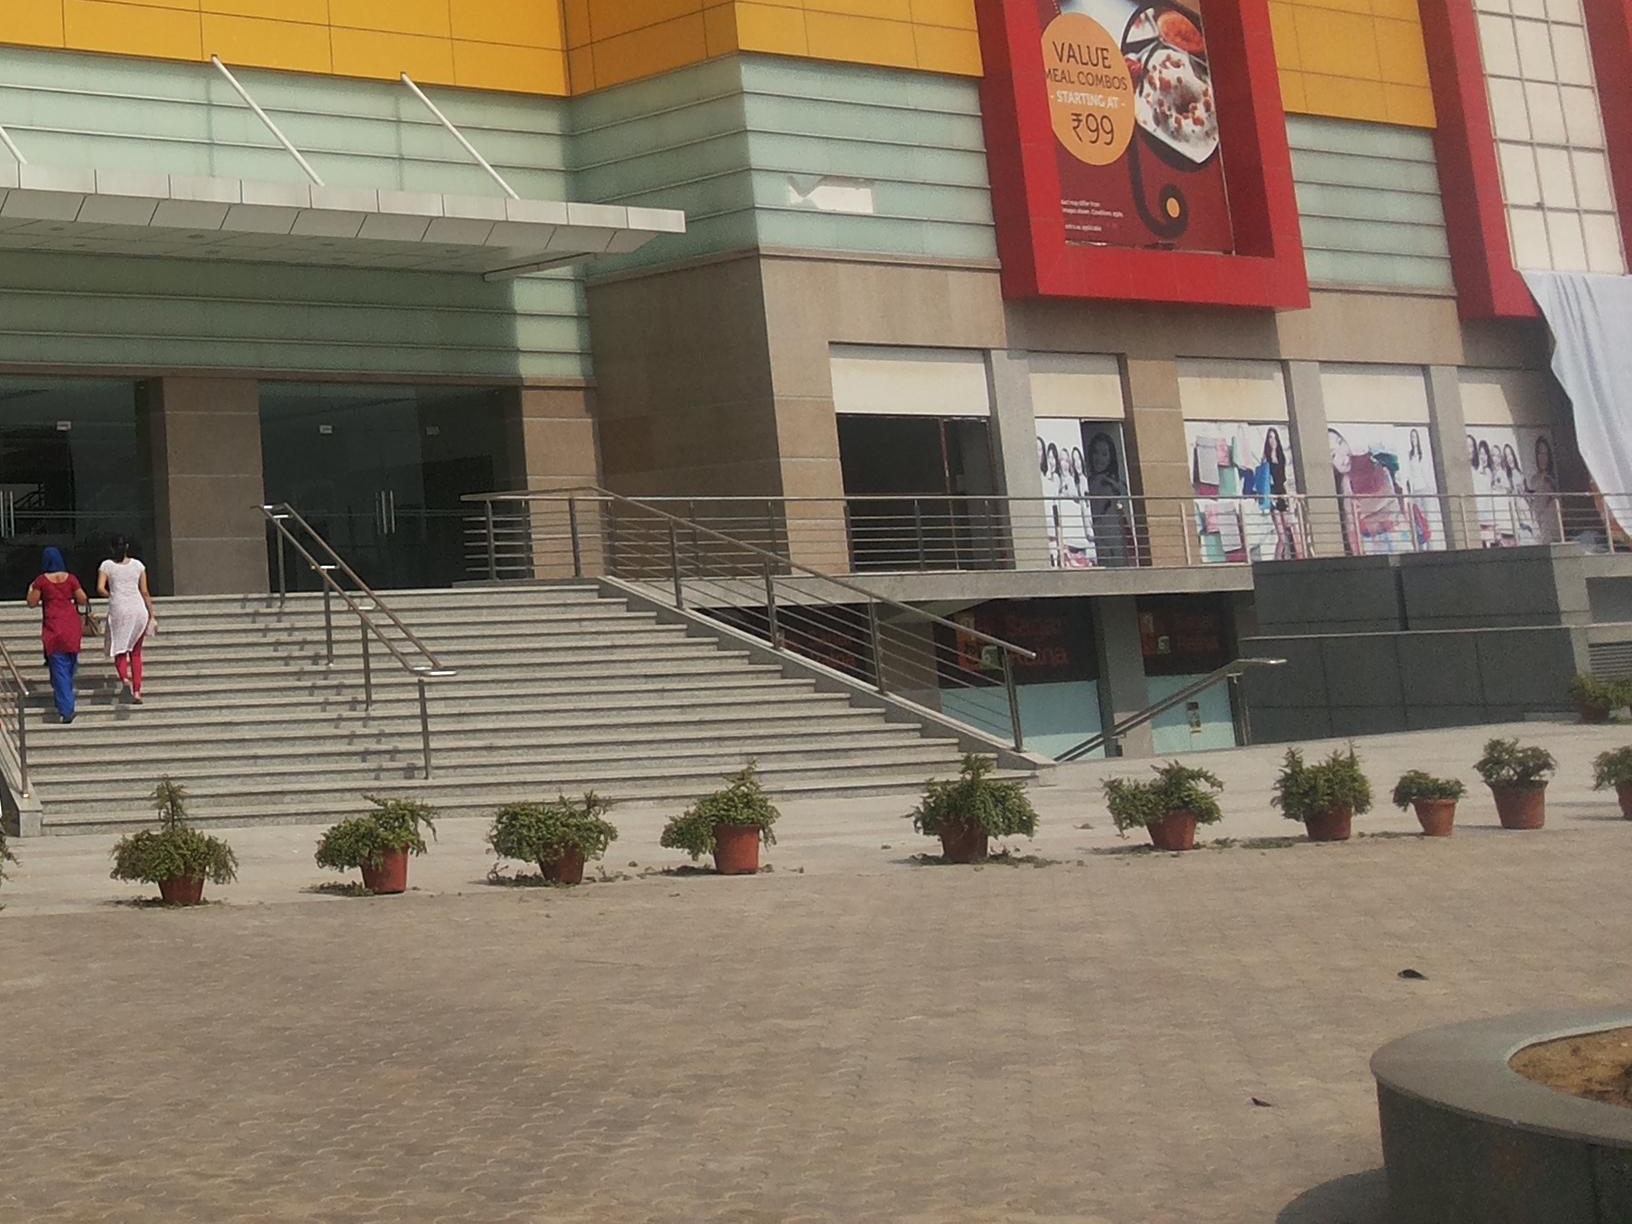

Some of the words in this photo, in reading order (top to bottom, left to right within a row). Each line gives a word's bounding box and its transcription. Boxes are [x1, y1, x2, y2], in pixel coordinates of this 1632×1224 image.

[1052, 40, 1113, 70] VALUE
[1077, 71, 1128, 91] COMBOS
[1056, 90, 1106, 108] STARTING
[1106, 96, 1120, 109] AT
